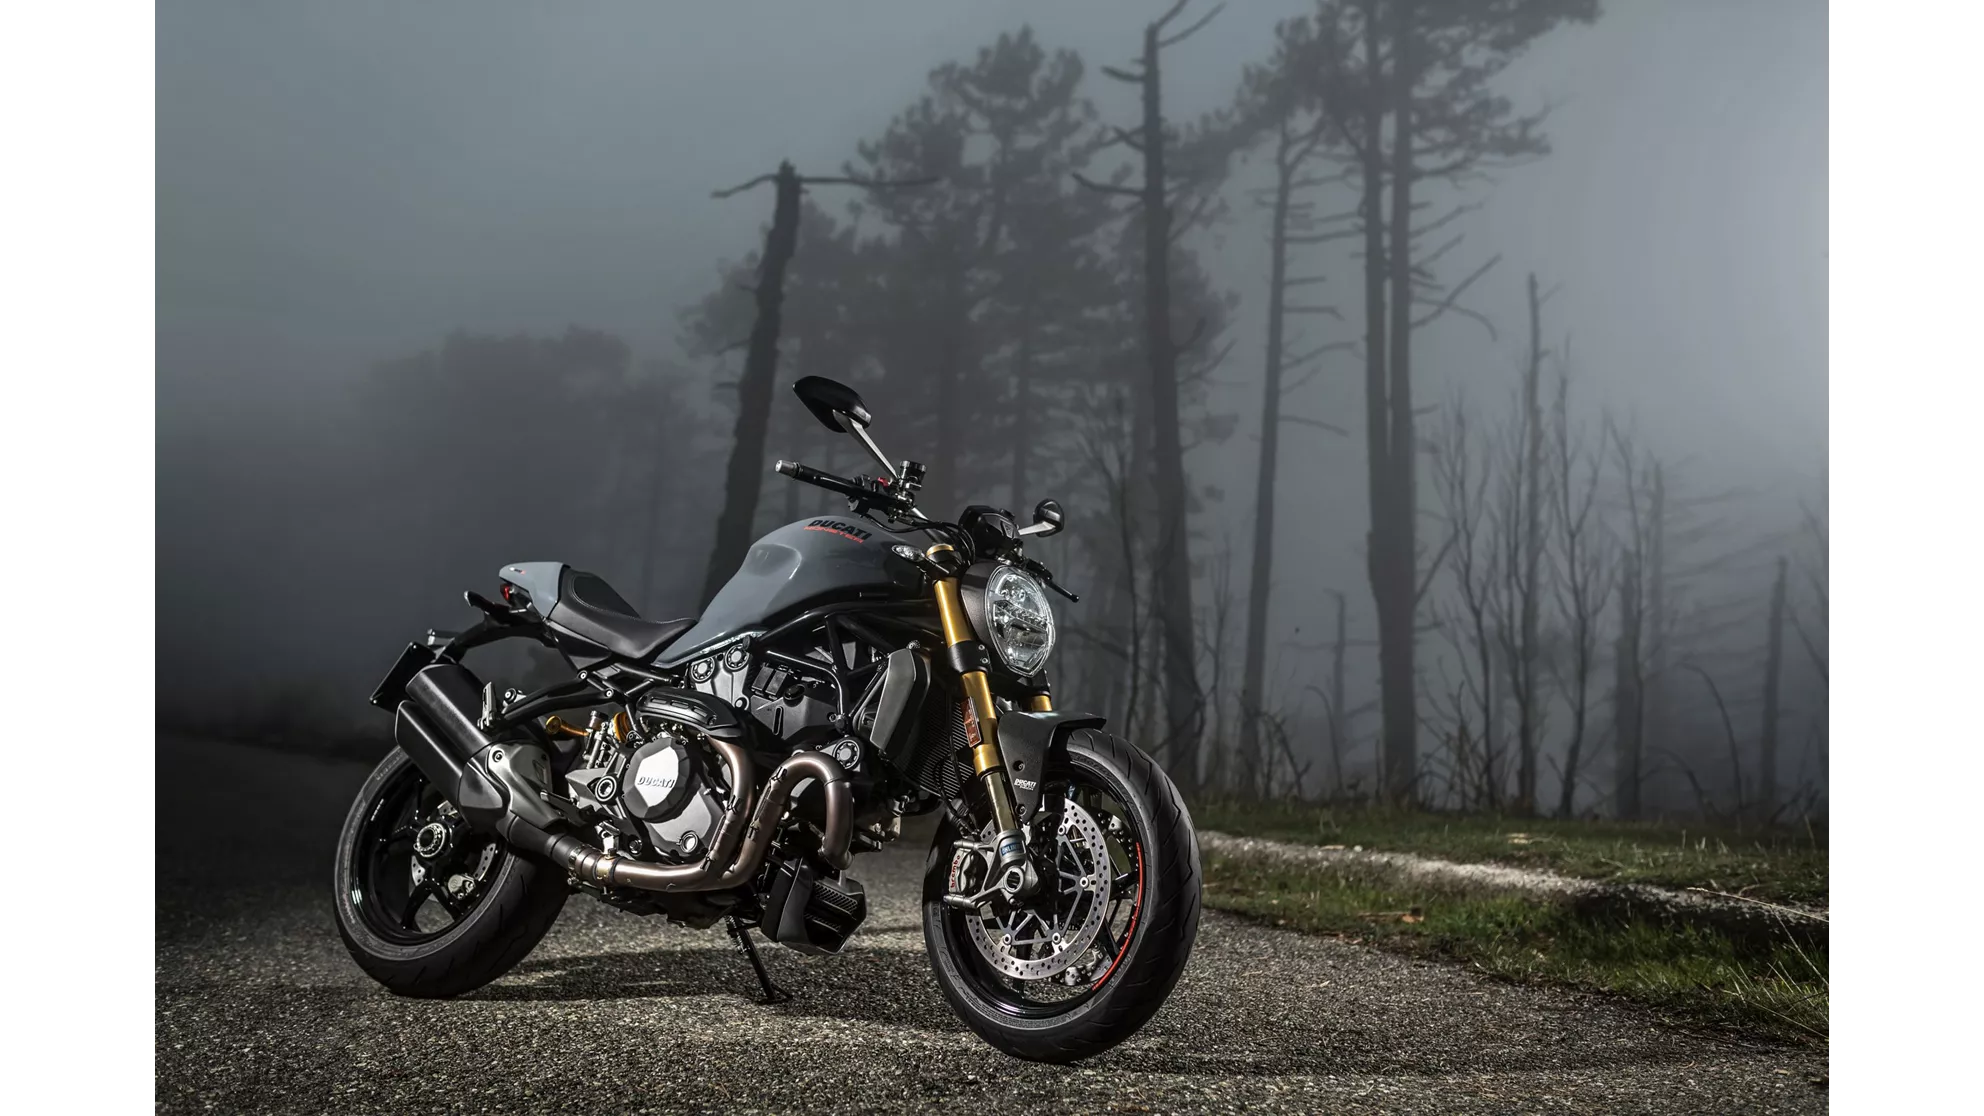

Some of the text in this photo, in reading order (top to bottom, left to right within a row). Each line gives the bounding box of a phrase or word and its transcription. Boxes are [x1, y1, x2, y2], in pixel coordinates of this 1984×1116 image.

[808, 519, 872, 540] DUCATI
[637, 777, 675, 788] DUCATI
[1014, 778, 1037, 788] DUCATI
[950, 855, 960, 888] brembo
